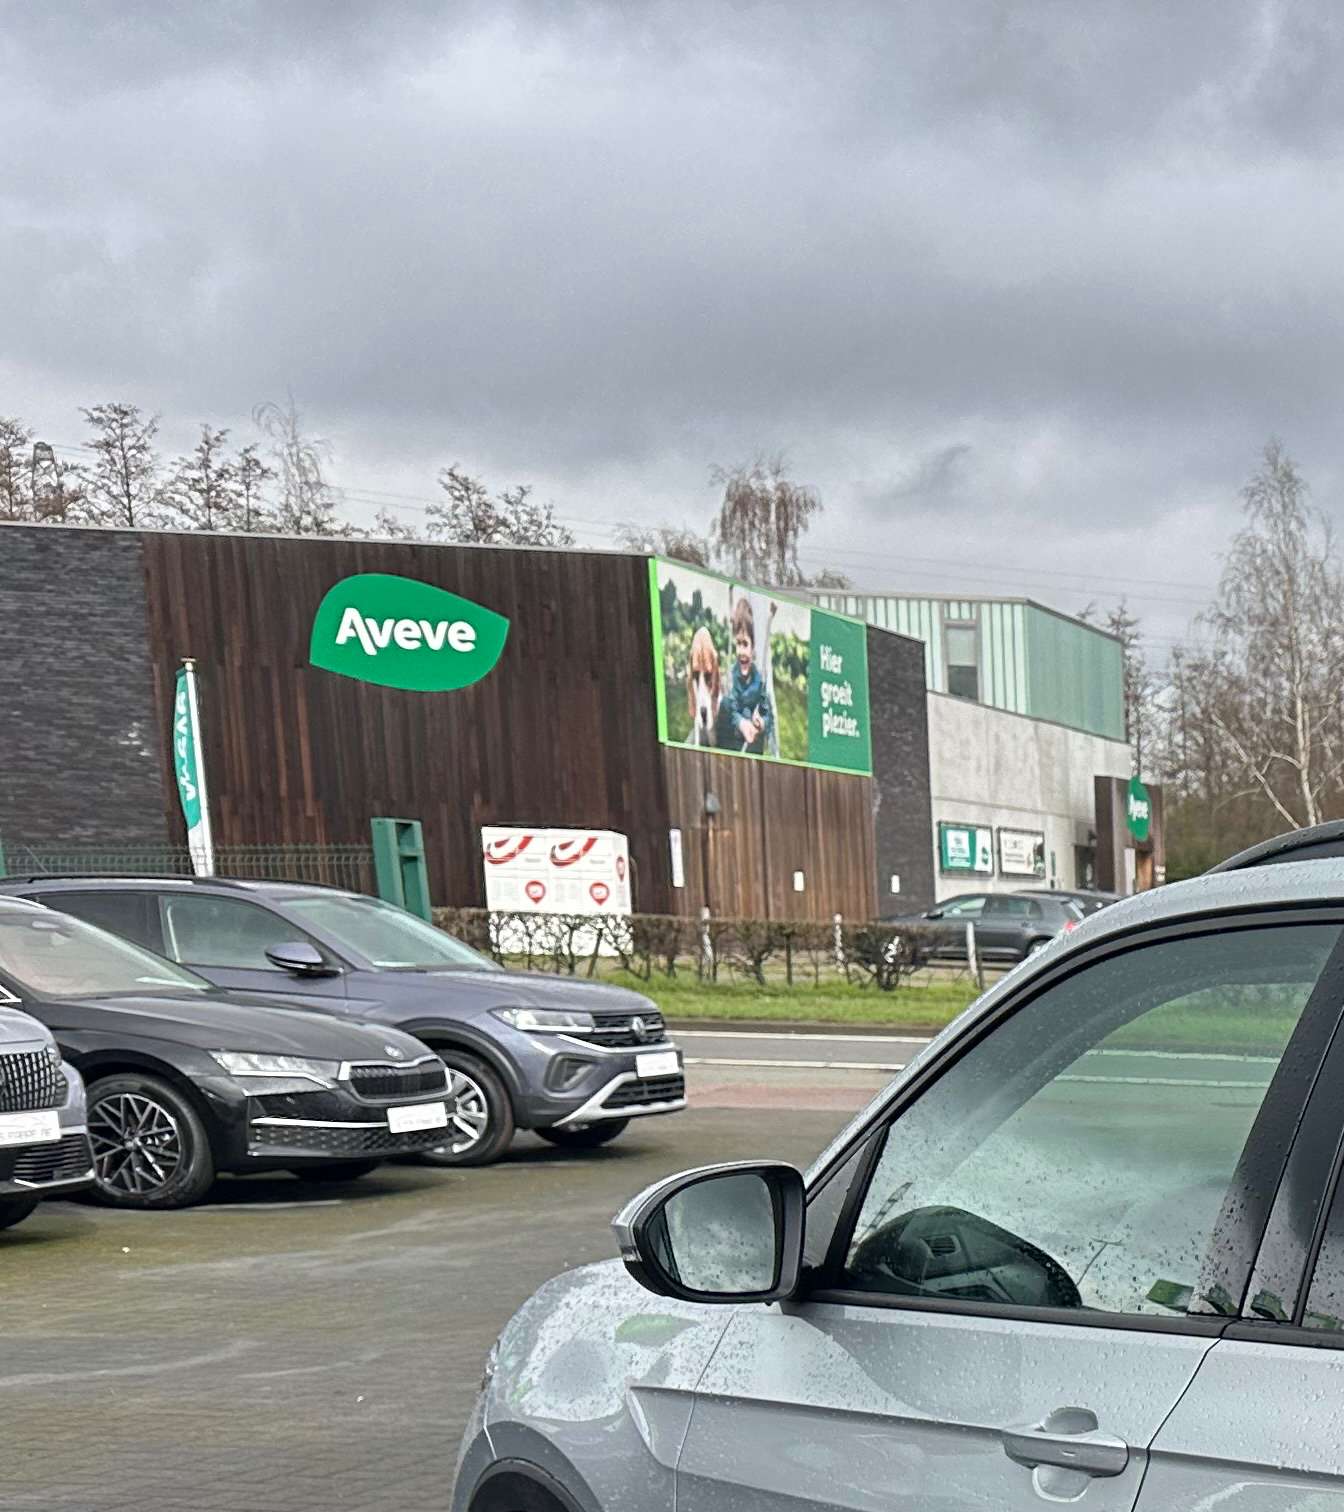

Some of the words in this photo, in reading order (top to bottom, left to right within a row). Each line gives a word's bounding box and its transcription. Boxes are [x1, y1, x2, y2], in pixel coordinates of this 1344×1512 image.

[335, 607, 477, 656] Aveve
[820, 644, 842, 674] Hier
[821, 680, 853, 708] groeit
